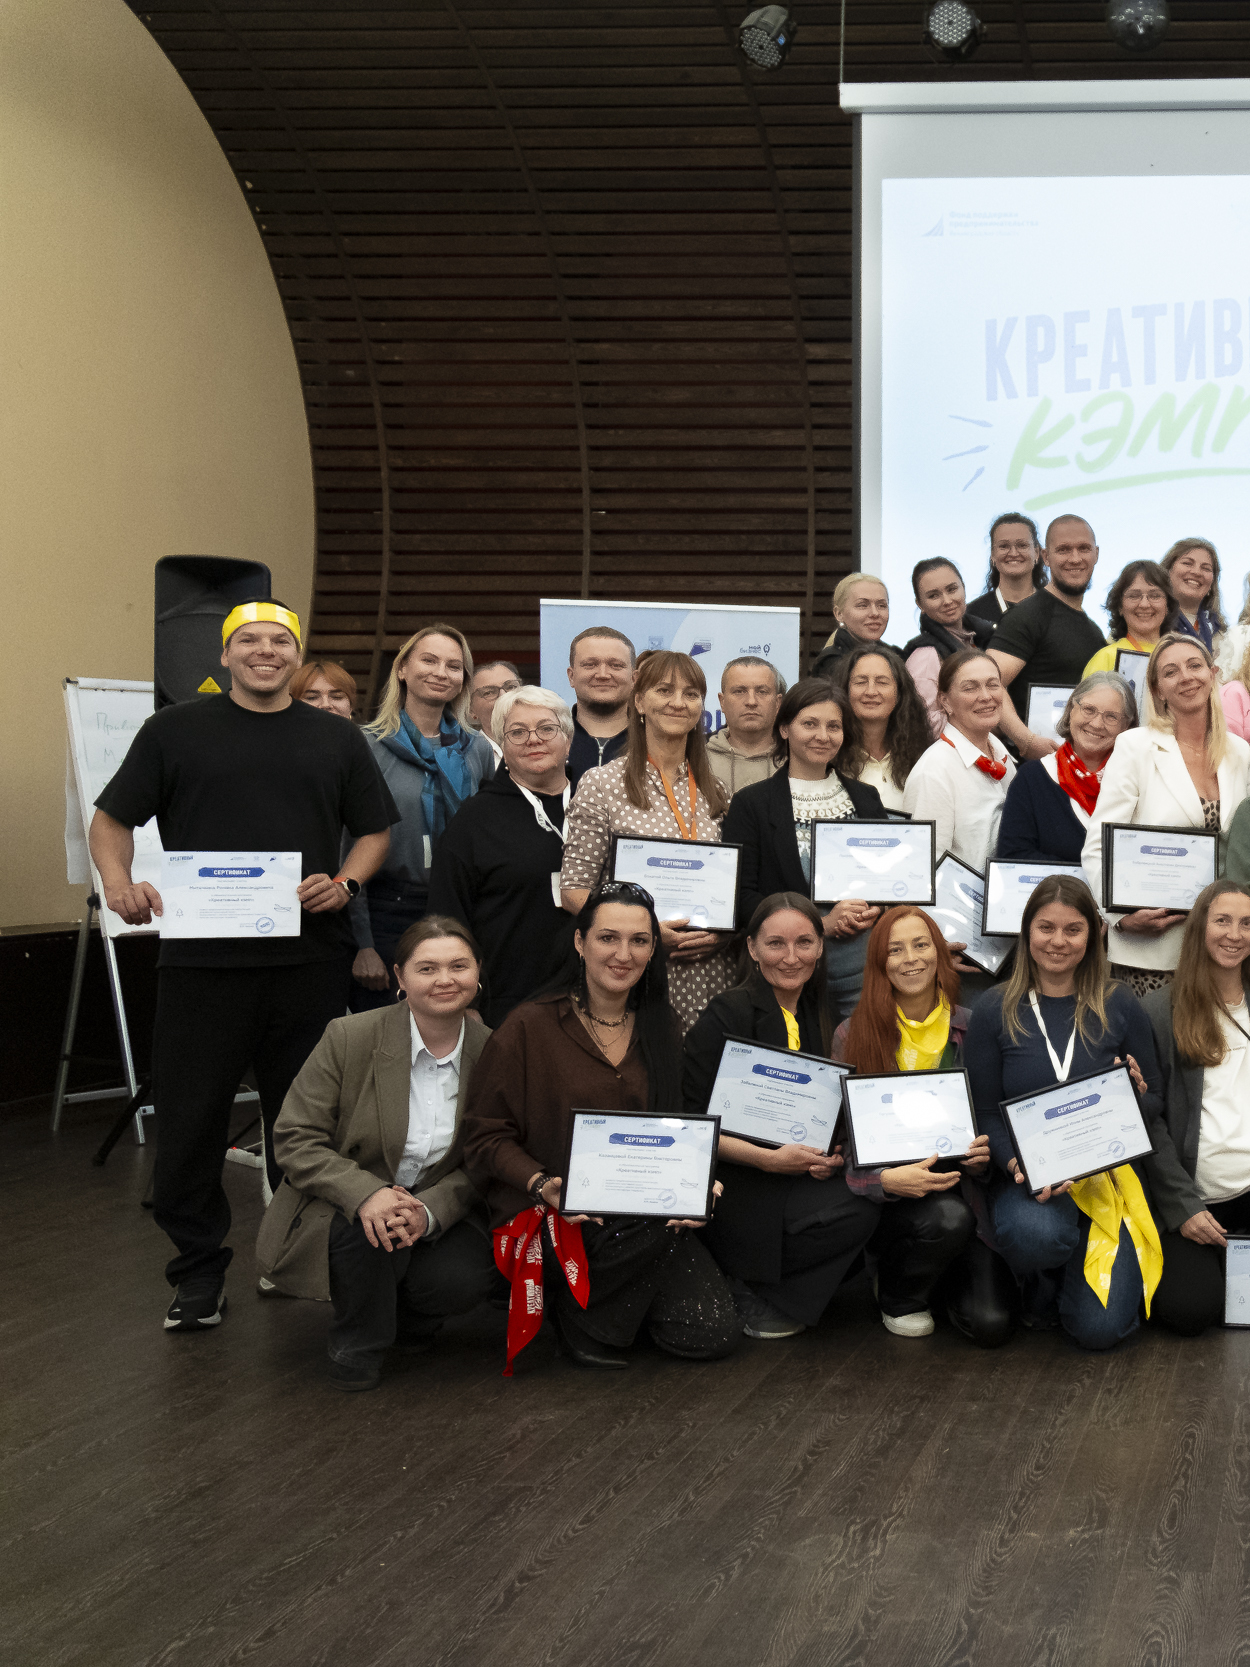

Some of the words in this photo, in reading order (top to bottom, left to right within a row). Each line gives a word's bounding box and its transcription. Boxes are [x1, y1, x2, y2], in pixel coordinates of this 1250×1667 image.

[659, 859, 693, 868] СЕРТИФИКАТ
[766, 1068, 799, 1081] СЕРТИФИКАТ
[1057, 1099, 1089, 1114] СЕРТИФИКАТ
[624, 1136, 661, 1144] СЕРТИФИКАТ
